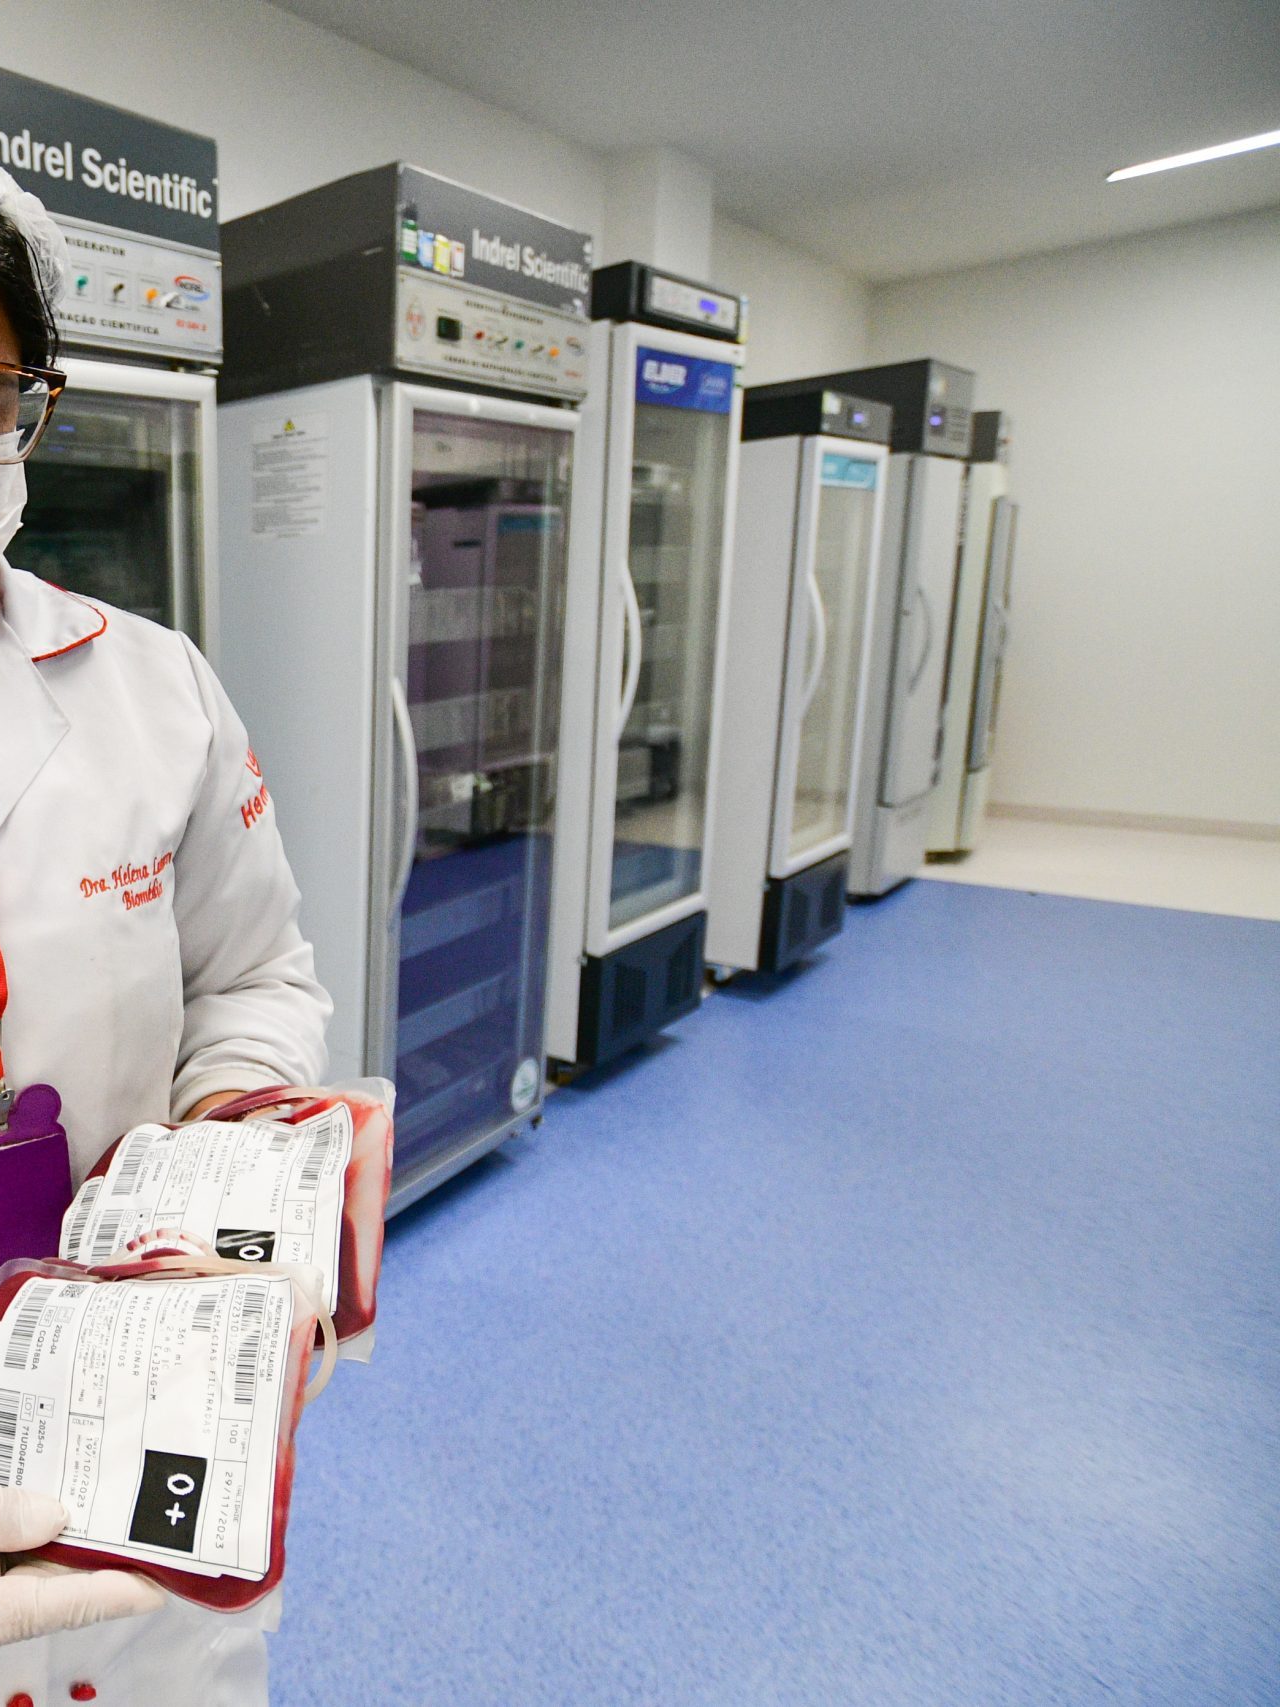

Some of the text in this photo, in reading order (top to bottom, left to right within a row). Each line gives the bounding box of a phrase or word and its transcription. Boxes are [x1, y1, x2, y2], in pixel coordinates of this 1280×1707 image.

[81, 147, 213, 219] Scientific
[472, 228, 589, 294] Indrel Scientific
[111, 862, 151, 890] Helena
[30, 1328, 47, 1371] CQ318BA
[48, 1323, 62, 1355] 2023-04
[116, 1294, 139, 1368] MEDICAMENTOS
[131, 1316, 147, 1377] ADICIONAR
[22, 1396, 34, 1417] LOT
[14, 1424, 29, 1486] 71UD04FB00
[34, 1418, 46, 1454] 2025-03
[227, 1422, 239, 1445] 100
[213, 1470, 234, 1550] 29/11/2023
